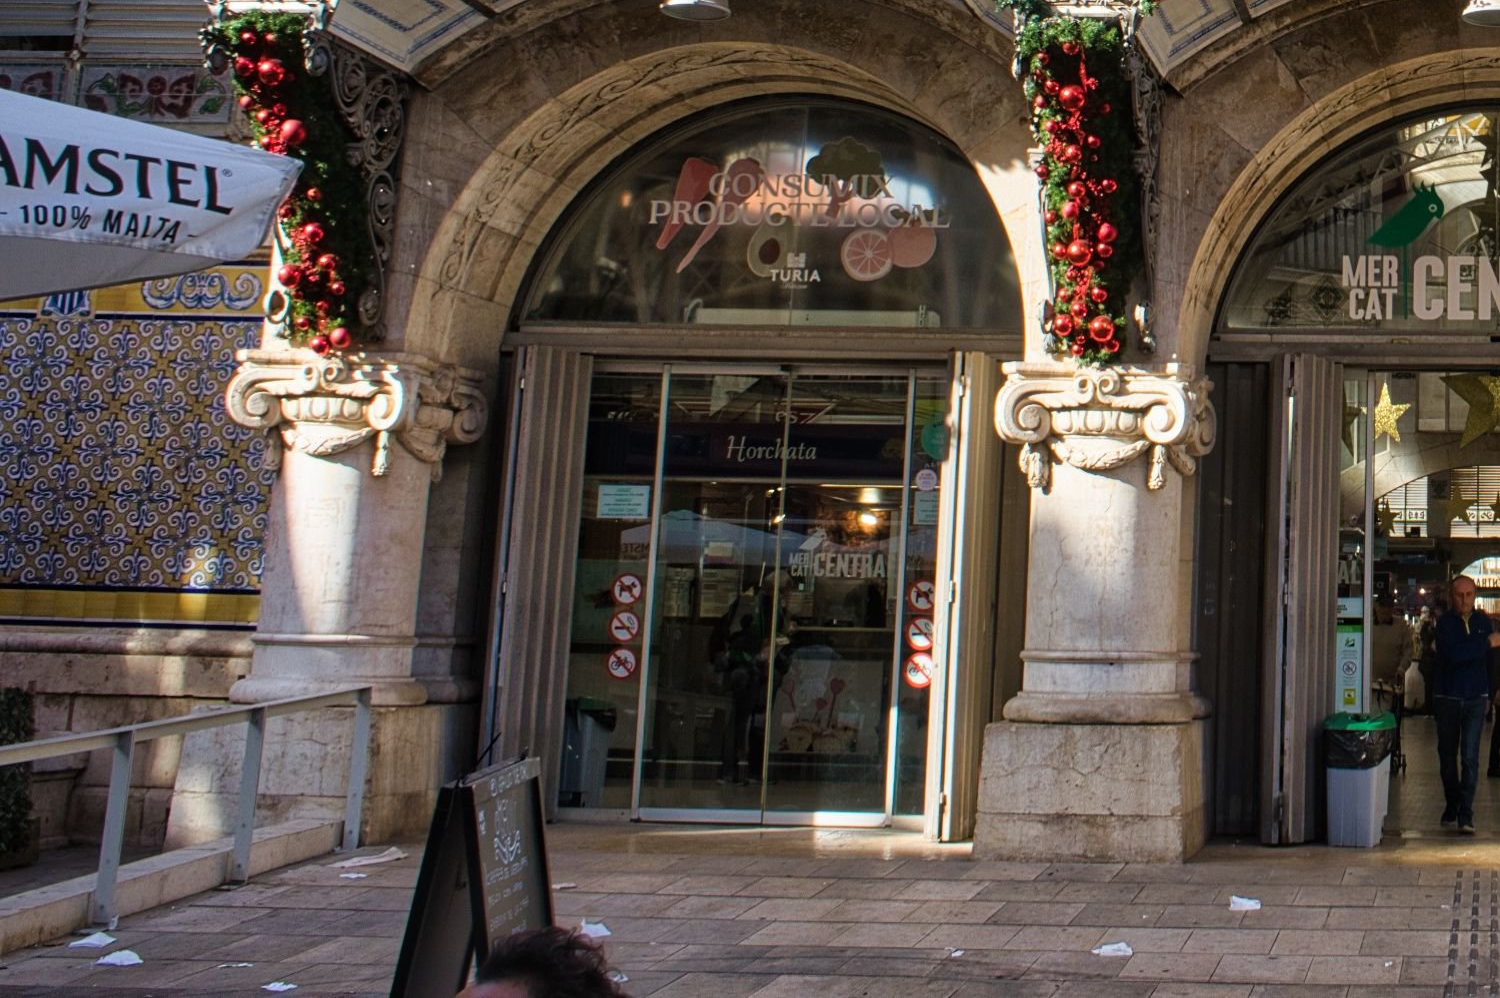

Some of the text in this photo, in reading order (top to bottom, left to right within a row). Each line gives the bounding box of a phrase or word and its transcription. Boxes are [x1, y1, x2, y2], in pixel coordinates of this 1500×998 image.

[709, 172, 895, 199] CONSUMIX
[19, 203, 182, 245] 100% MALTA
[648, 199, 951, 229] PRODUCTE LOCAL
[769, 268, 822, 283] TURIA
[1341, 255, 1399, 288] MER
[1348, 288, 1399, 321] CAT
[726, 435, 818, 462] Horchata
[789, 552, 810, 565] MER
[790, 565, 809, 577] CAT
